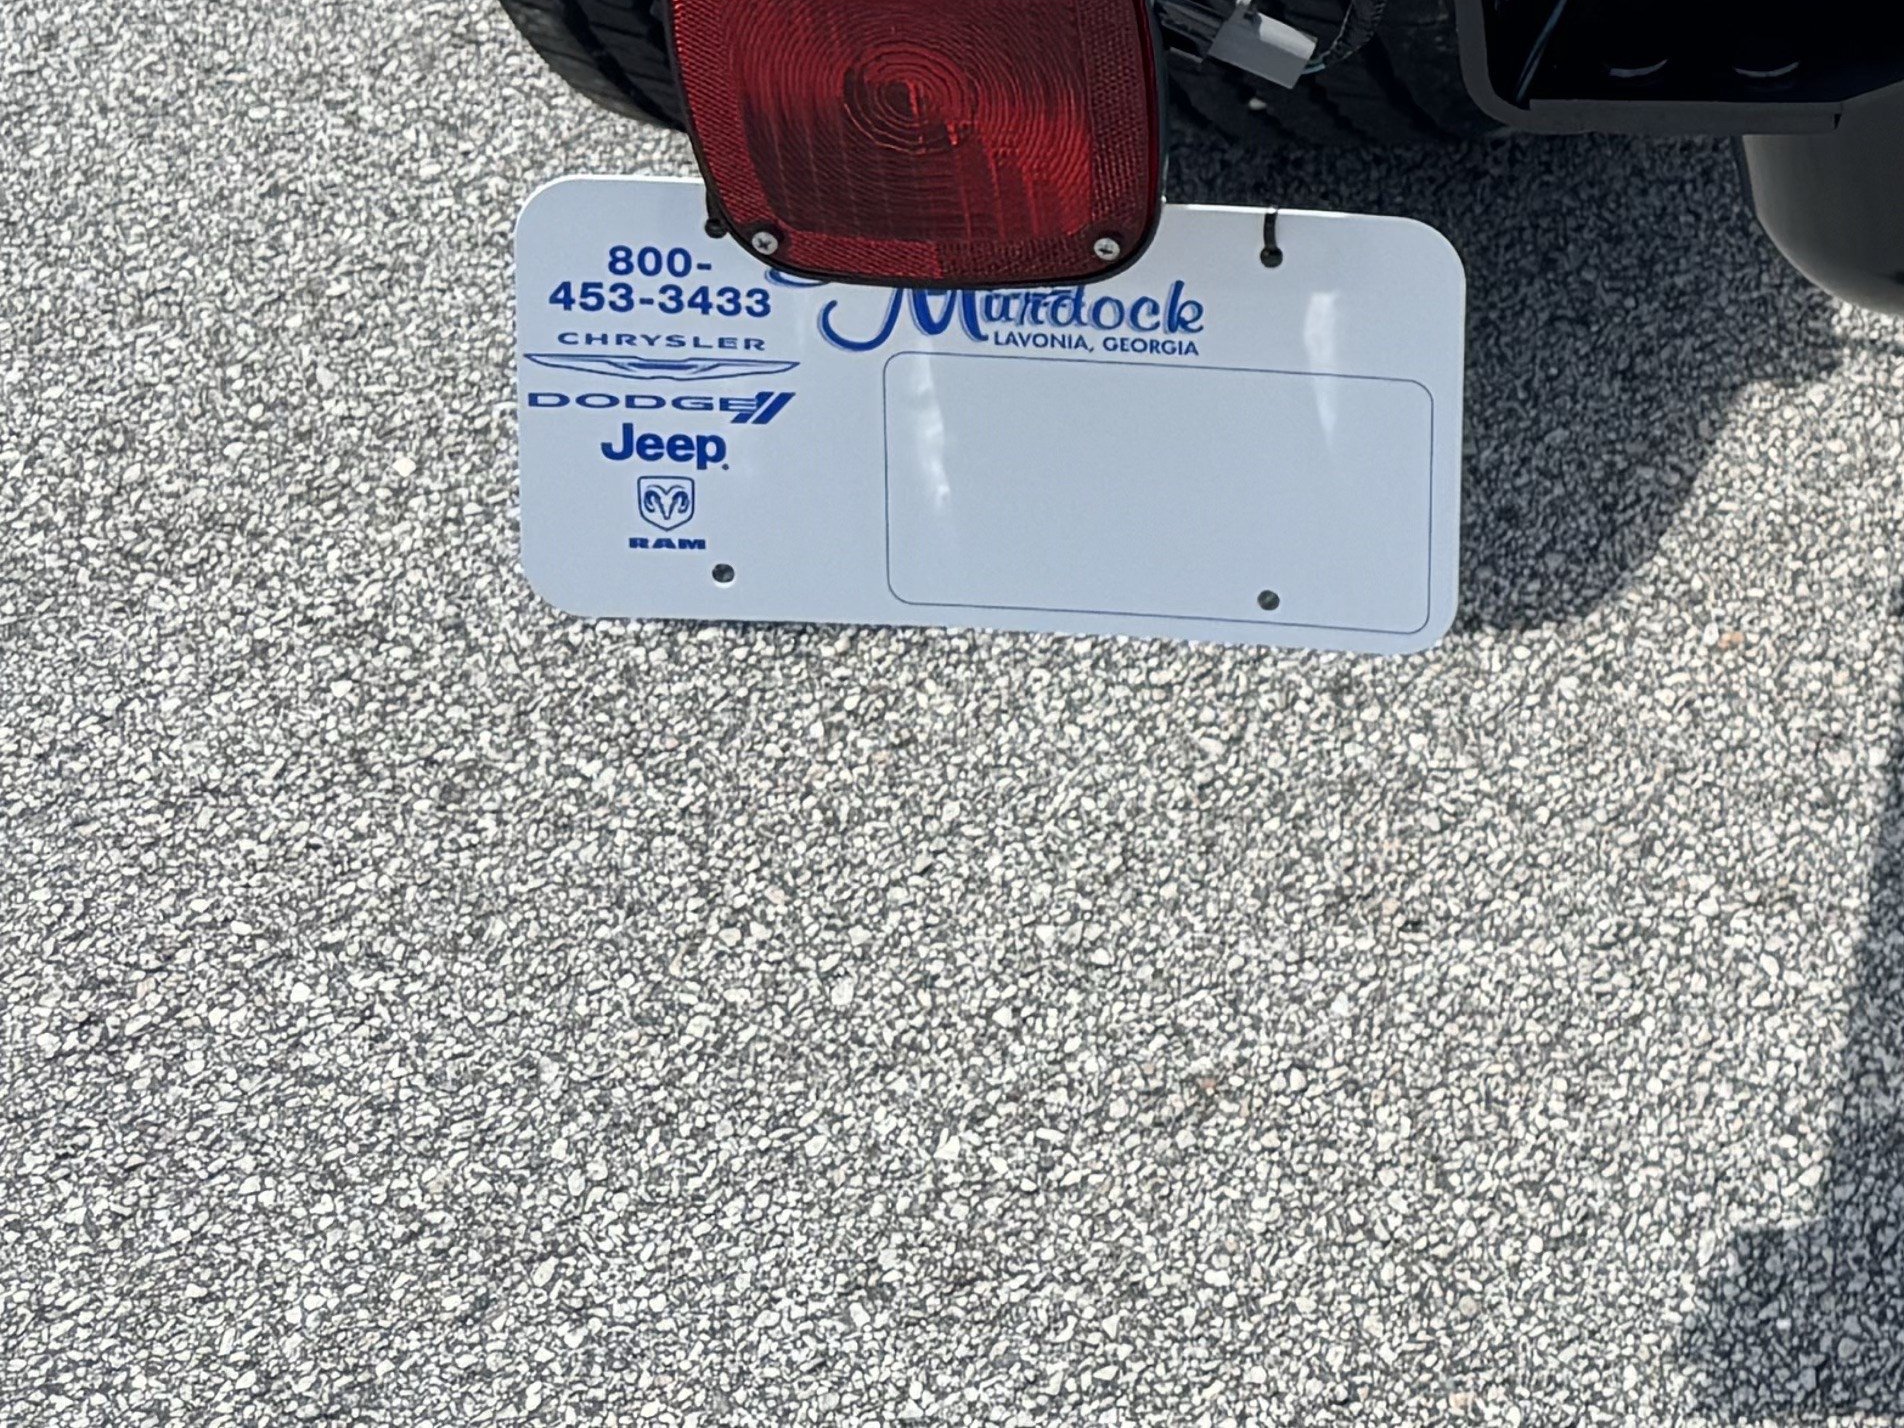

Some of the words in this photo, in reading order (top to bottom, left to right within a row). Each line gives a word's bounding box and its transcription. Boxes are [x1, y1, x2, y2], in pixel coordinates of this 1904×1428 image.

[608, 245, 712, 278] 800-
[549, 281, 771, 318] 453-3433
[558, 331, 766, 351] CHRYSLER
[993, 330, 1094, 353] LAVONIA,
[1101, 334, 1200, 356] GEORGIA
[527, 392, 757, 413] DODGE
[628, 537, 707, 550] RAM
